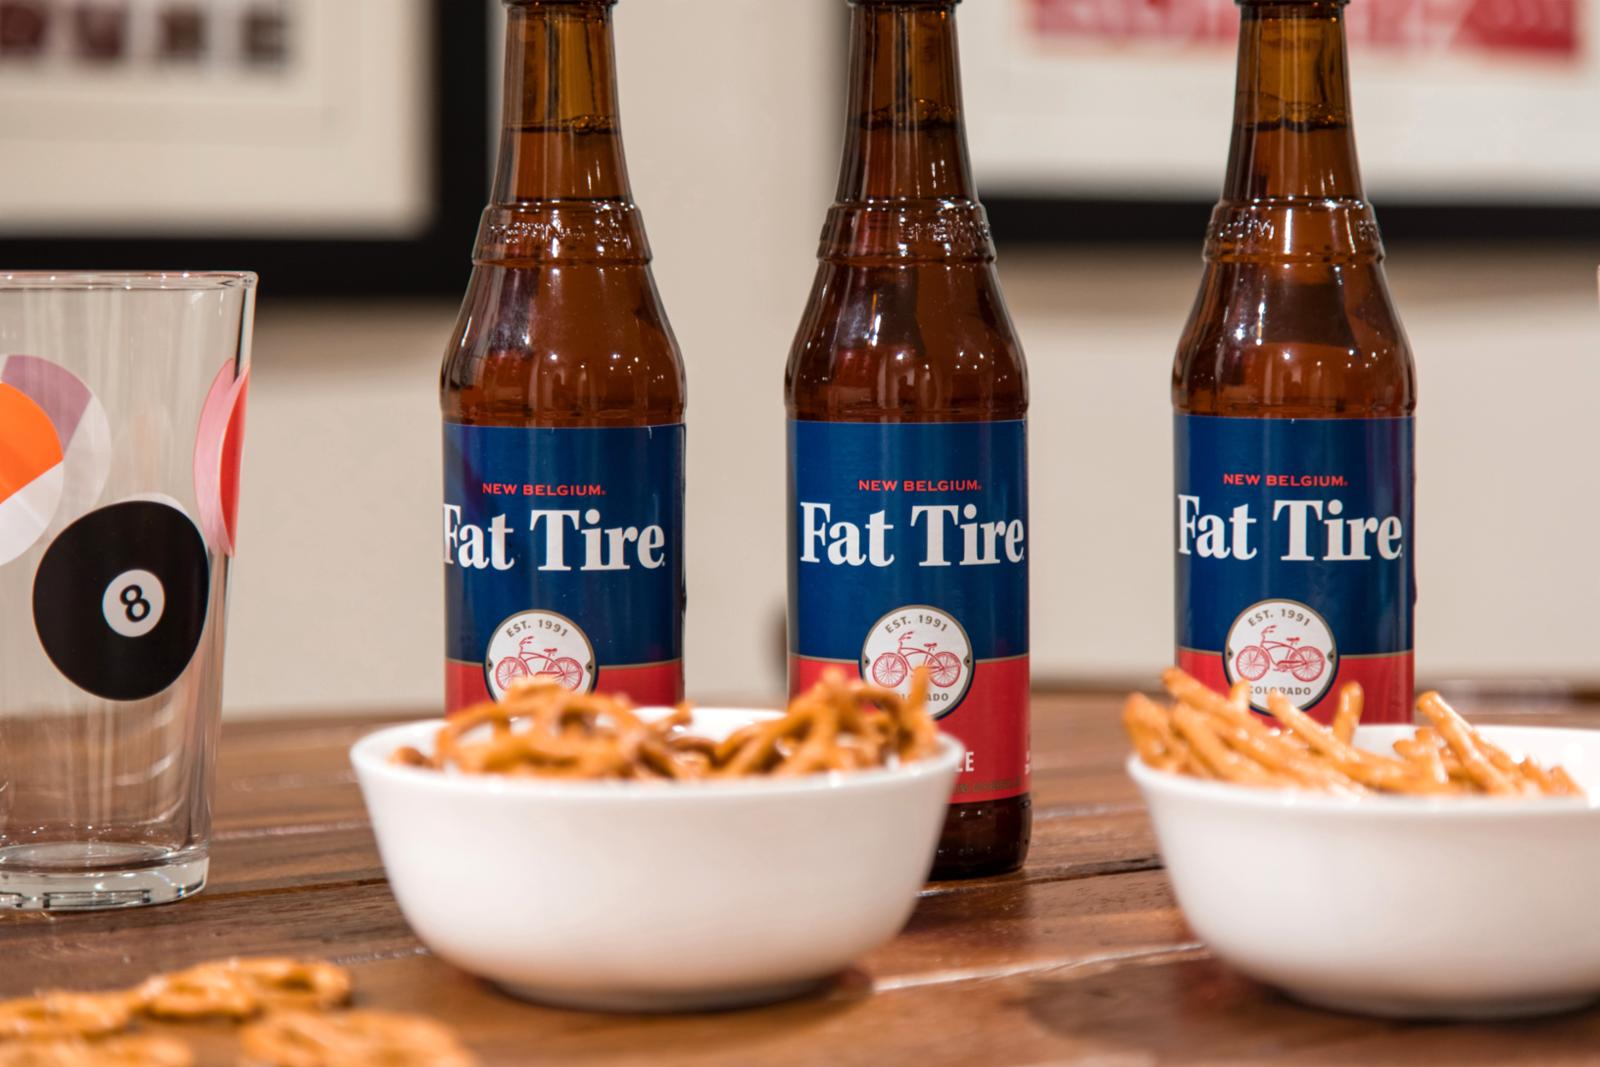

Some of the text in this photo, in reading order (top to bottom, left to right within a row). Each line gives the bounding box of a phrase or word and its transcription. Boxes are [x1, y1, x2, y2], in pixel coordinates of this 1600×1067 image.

[858, 480, 898, 491] NEW
[1223, 473, 1260, 485] NEW
[482, 483, 517, 495] NEW
[800, 501, 1024, 567] Fat Tire
[1178, 494, 1402, 561] Fat Tire
[443, 503, 665, 571] Fat Tire
[119, 583, 151, 623] 8
[885, 614, 948, 633] EST. 1991
[1248, 608, 1310, 626] EST. 1991
[506, 619, 568, 637] EST. 1991
